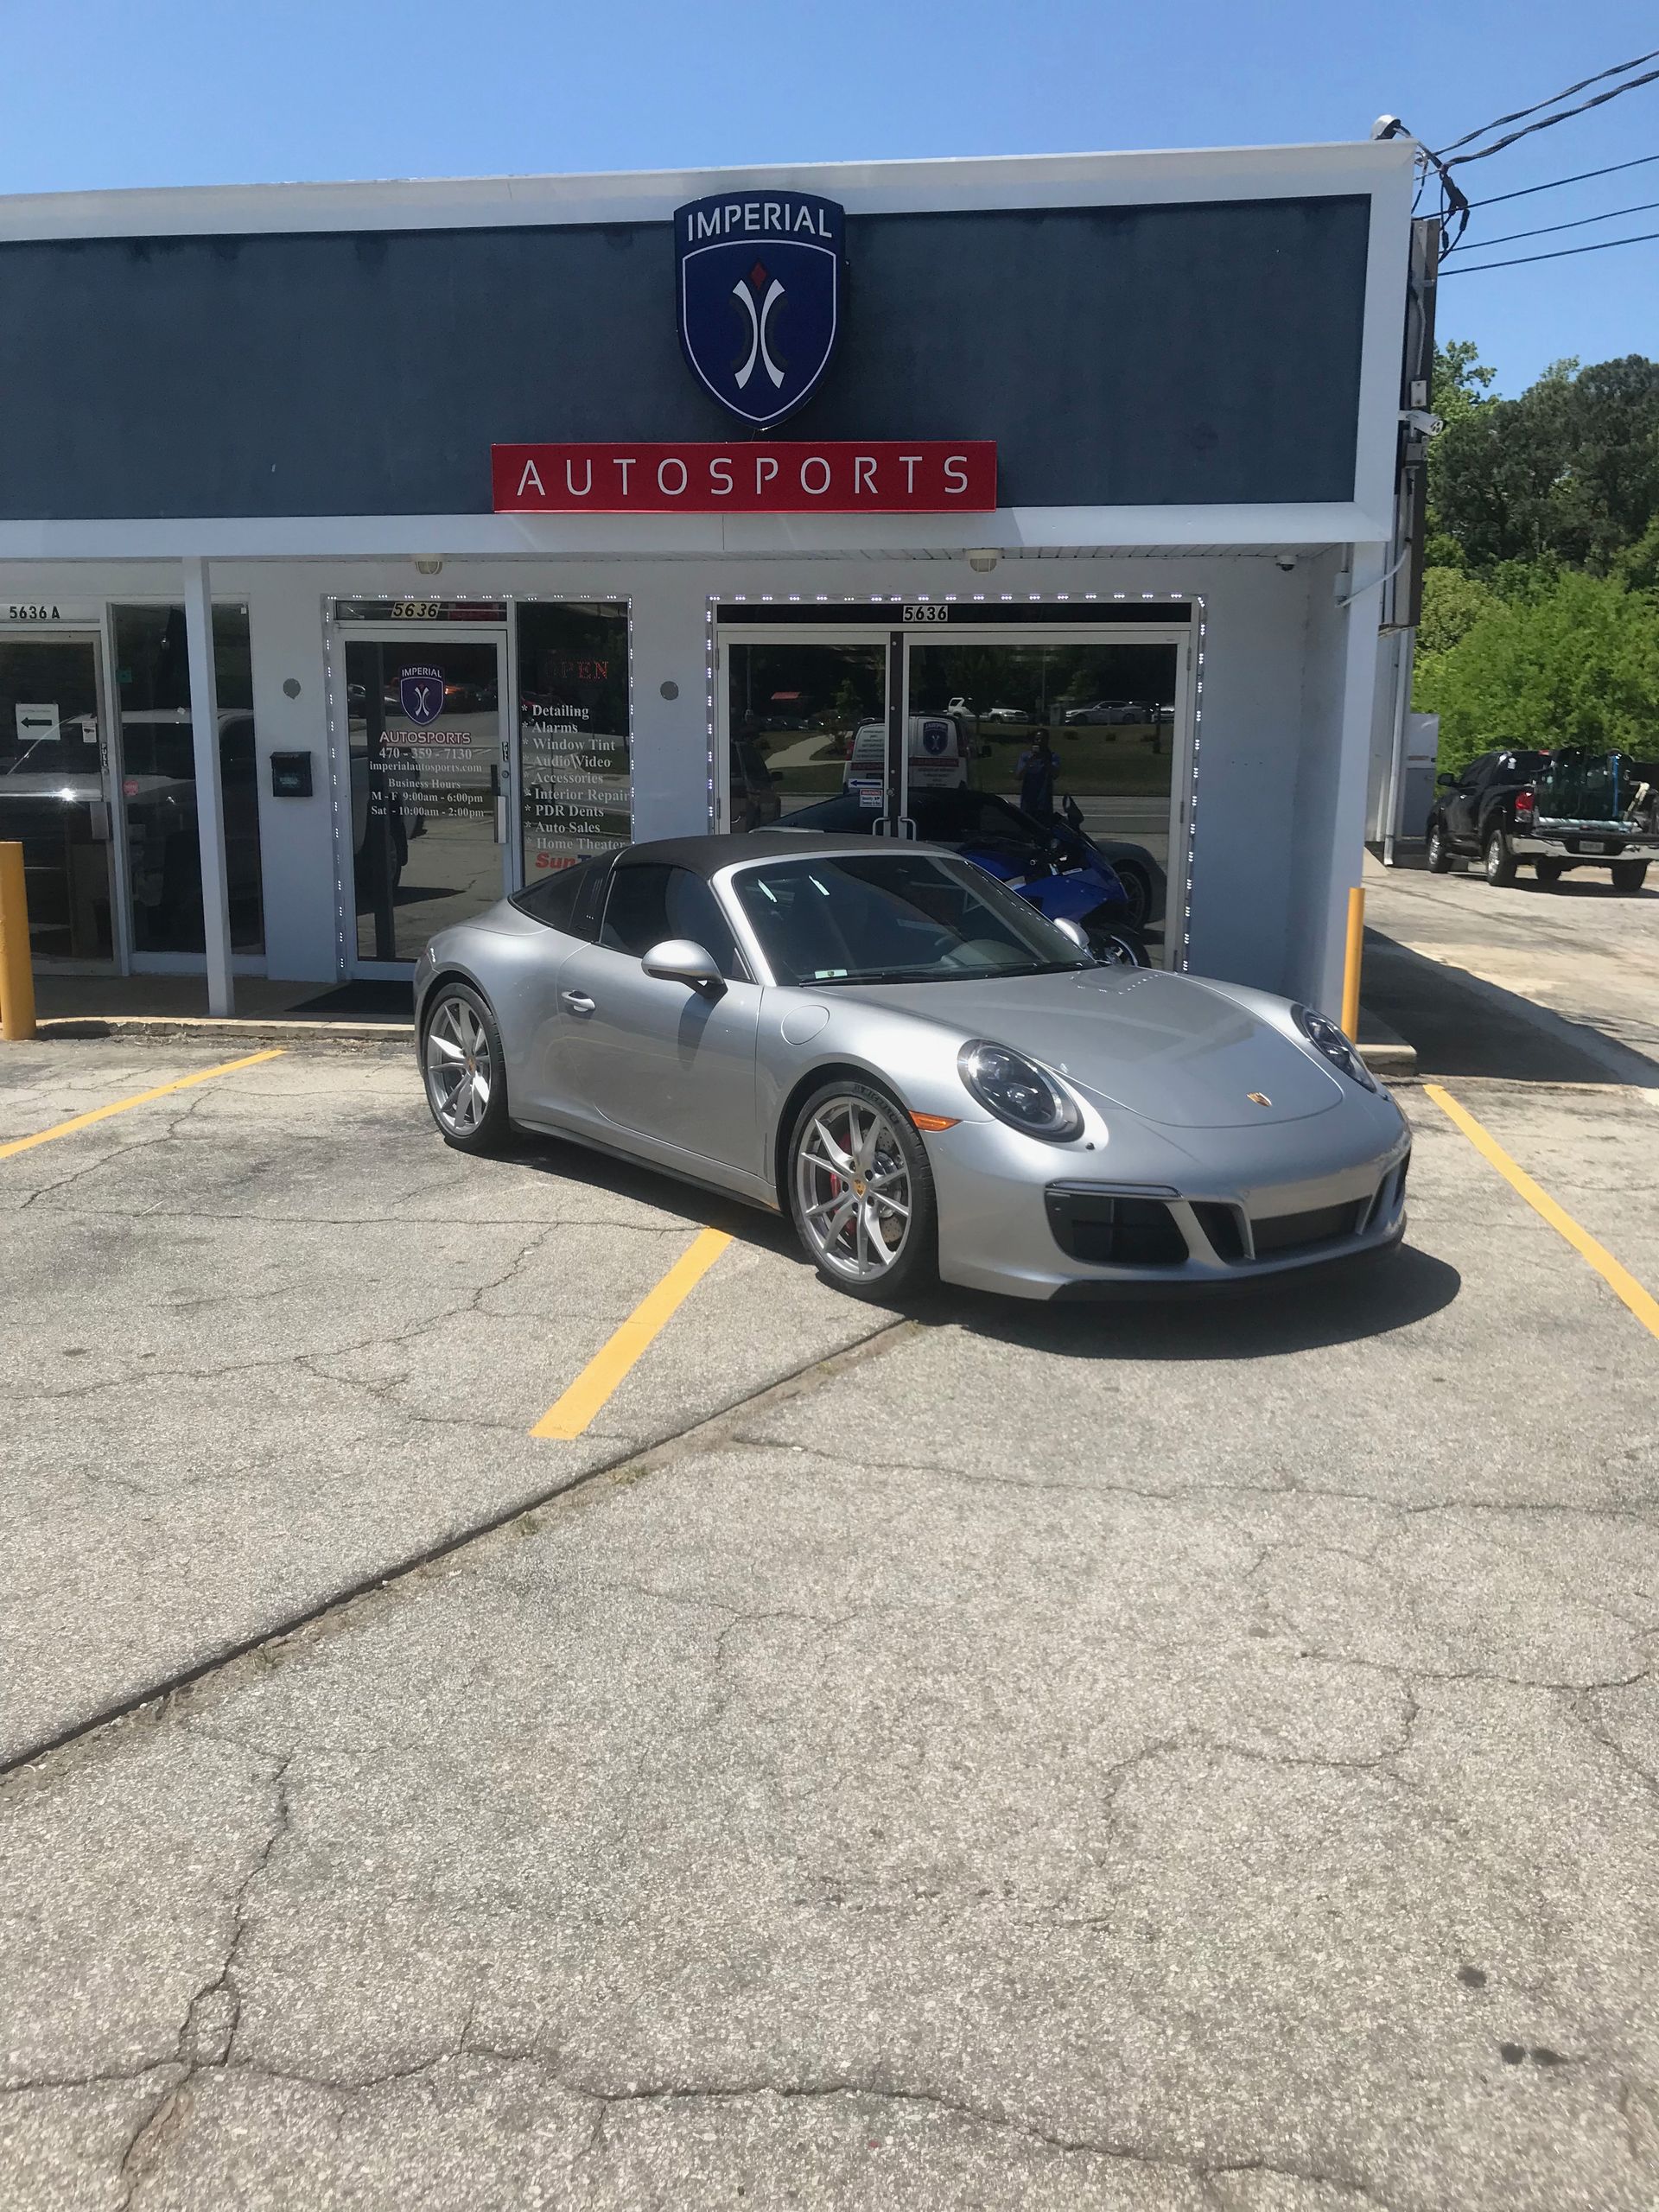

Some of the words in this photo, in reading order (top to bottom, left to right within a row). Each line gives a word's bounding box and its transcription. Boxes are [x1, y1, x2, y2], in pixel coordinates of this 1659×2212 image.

[687, 201, 832, 242] IMPERIAL
[517, 455, 969, 497] AUTOSPORTS
[10, 606, 48, 620] 5636
[393, 603, 438, 617] 5636
[904, 606, 947, 620] 5636
[402, 667, 442, 678] IMPERIAL
[532, 704, 589, 720] Detailing
[532, 721, 578, 734] Alarms
[379, 731, 472, 744] AUTOSPORTS
[533, 738, 585, 751] Window
[588, 739, 616, 751] Tint
[379, 747, 400, 759] 470
[411, 747, 433, 760] 359
[444, 748, 472, 760] 7130
[370, 761, 482, 772] imperialautosports.com
[389, 779, 429, 788] Business
[432, 779, 461, 789] Hours
[535, 772, 604, 784] Accessories
[372, 791, 381, 801] M
[391, 792, 398, 801] F
[403, 792, 438, 802] 9:00am
[447, 794, 483, 804] 6:00pm
[535, 787, 584, 800] Interior
[588, 789, 629, 804] Repair
[372, 805, 387, 816] Sat
[399, 807, 440, 817] 10:00am
[448, 808, 484, 818] 2:00pm
[536, 804, 565, 817] PDR
[569, 805, 605, 817] Dents
[535, 821, 566, 833] Auto
[569, 821, 601, 833] Sales
[537, 838, 574, 849] Home
[576, 838, 626, 850] Theater
